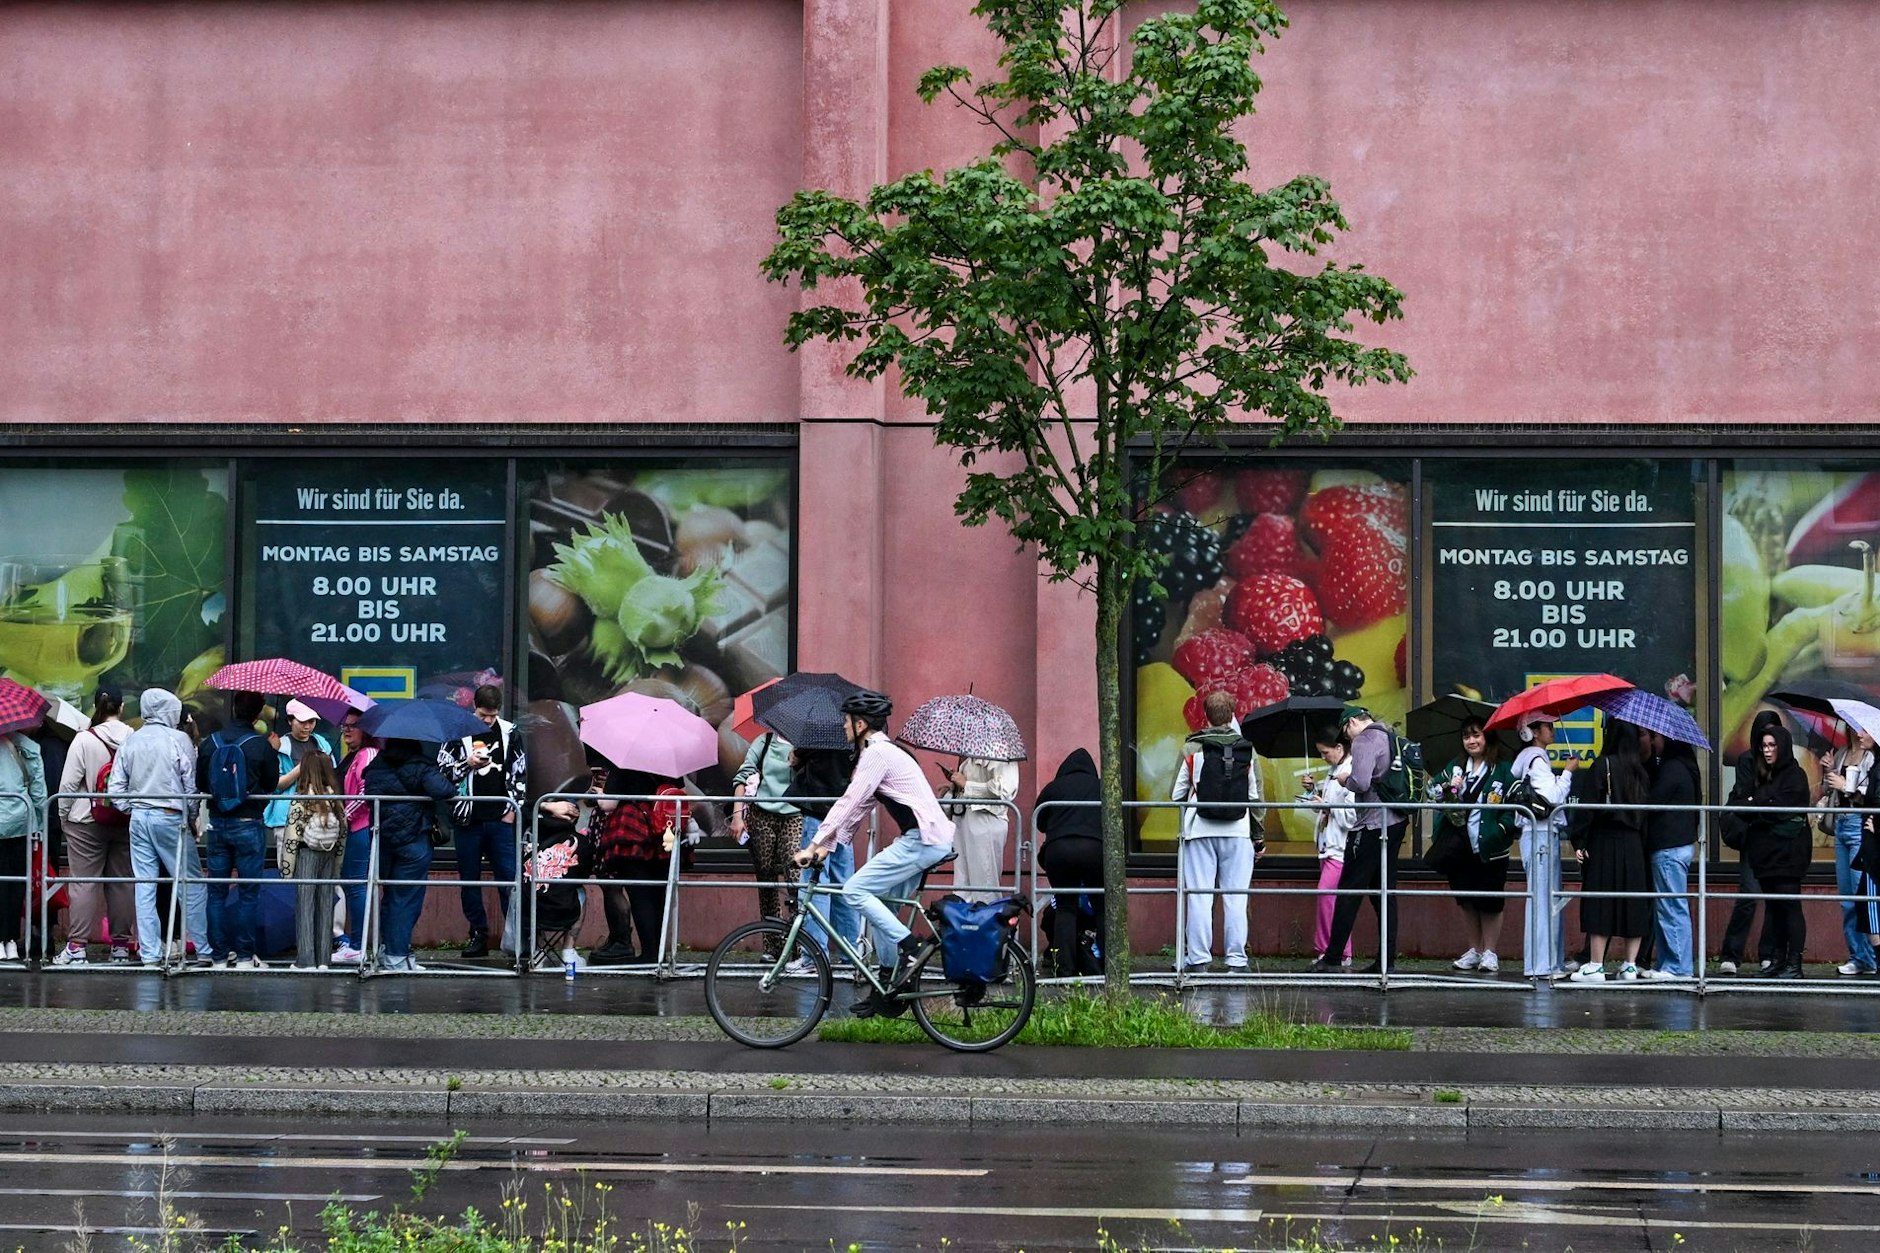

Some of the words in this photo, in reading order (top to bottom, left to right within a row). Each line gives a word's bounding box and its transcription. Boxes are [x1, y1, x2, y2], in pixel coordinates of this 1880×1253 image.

[297, 488, 328, 510] Wir
[332, 488, 370, 510] sind
[375, 488, 402, 510] für
[406, 488, 434, 510] Sie
[438, 488, 465, 510] da.
[1475, 489, 1508, 512] Wir
[1513, 489, 1552, 512] sind
[1558, 489, 1587, 512] für
[1591, 489, 1620, 512] Sie
[1625, 489, 1653, 512] da.
[262, 545, 351, 562] MONTAG
[358, 546, 392, 563] BIS
[399, 545, 499, 562] SAMSTAG
[1439, 548, 1533, 566] MONTAG
[1541, 549, 1577, 566] BIS
[1584, 548, 1689, 566] SAMSTAG
[312, 576, 371, 596] 8.00
[381, 576, 437, 596] UHR
[1493, 580, 1556, 601] 8.00
[1566, 580, 1625, 601] UHR
[358, 599, 400, 620] BIS
[1542, 604, 1587, 625] BIS
[311, 622, 381, 643] 21.00
[391, 622, 447, 643] UHR
[1492, 627, 1566, 649] 21.00
[1577, 628, 1637, 649] UHR
[1546, 749, 1597, 761] DEKA
